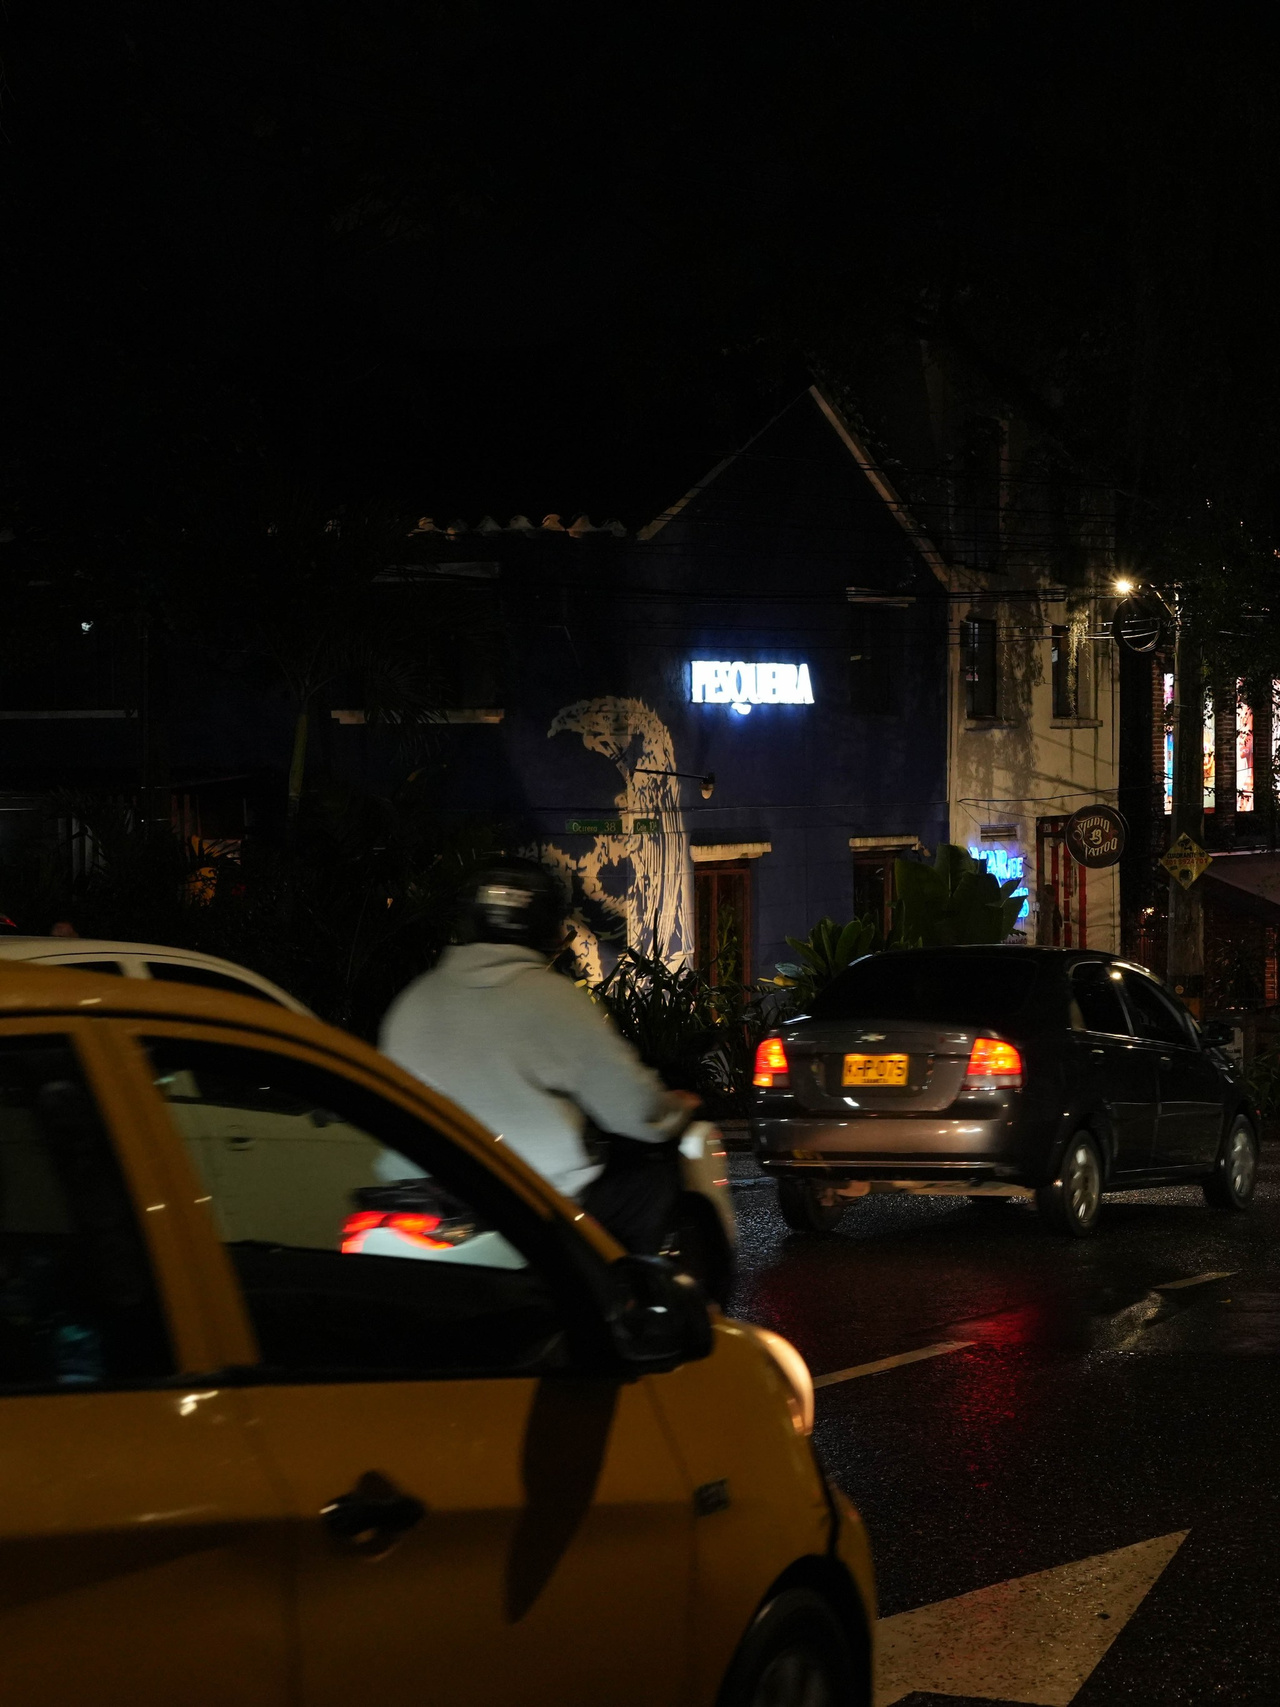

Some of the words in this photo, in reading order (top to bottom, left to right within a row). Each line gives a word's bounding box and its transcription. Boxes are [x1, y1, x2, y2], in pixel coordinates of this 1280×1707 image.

[691, 660, 815, 714] PESQUERA
[604, 821, 616, 832] 38
[1076, 817, 1110, 834] STUDIO
[1084, 837, 1118, 860] TATTOO
